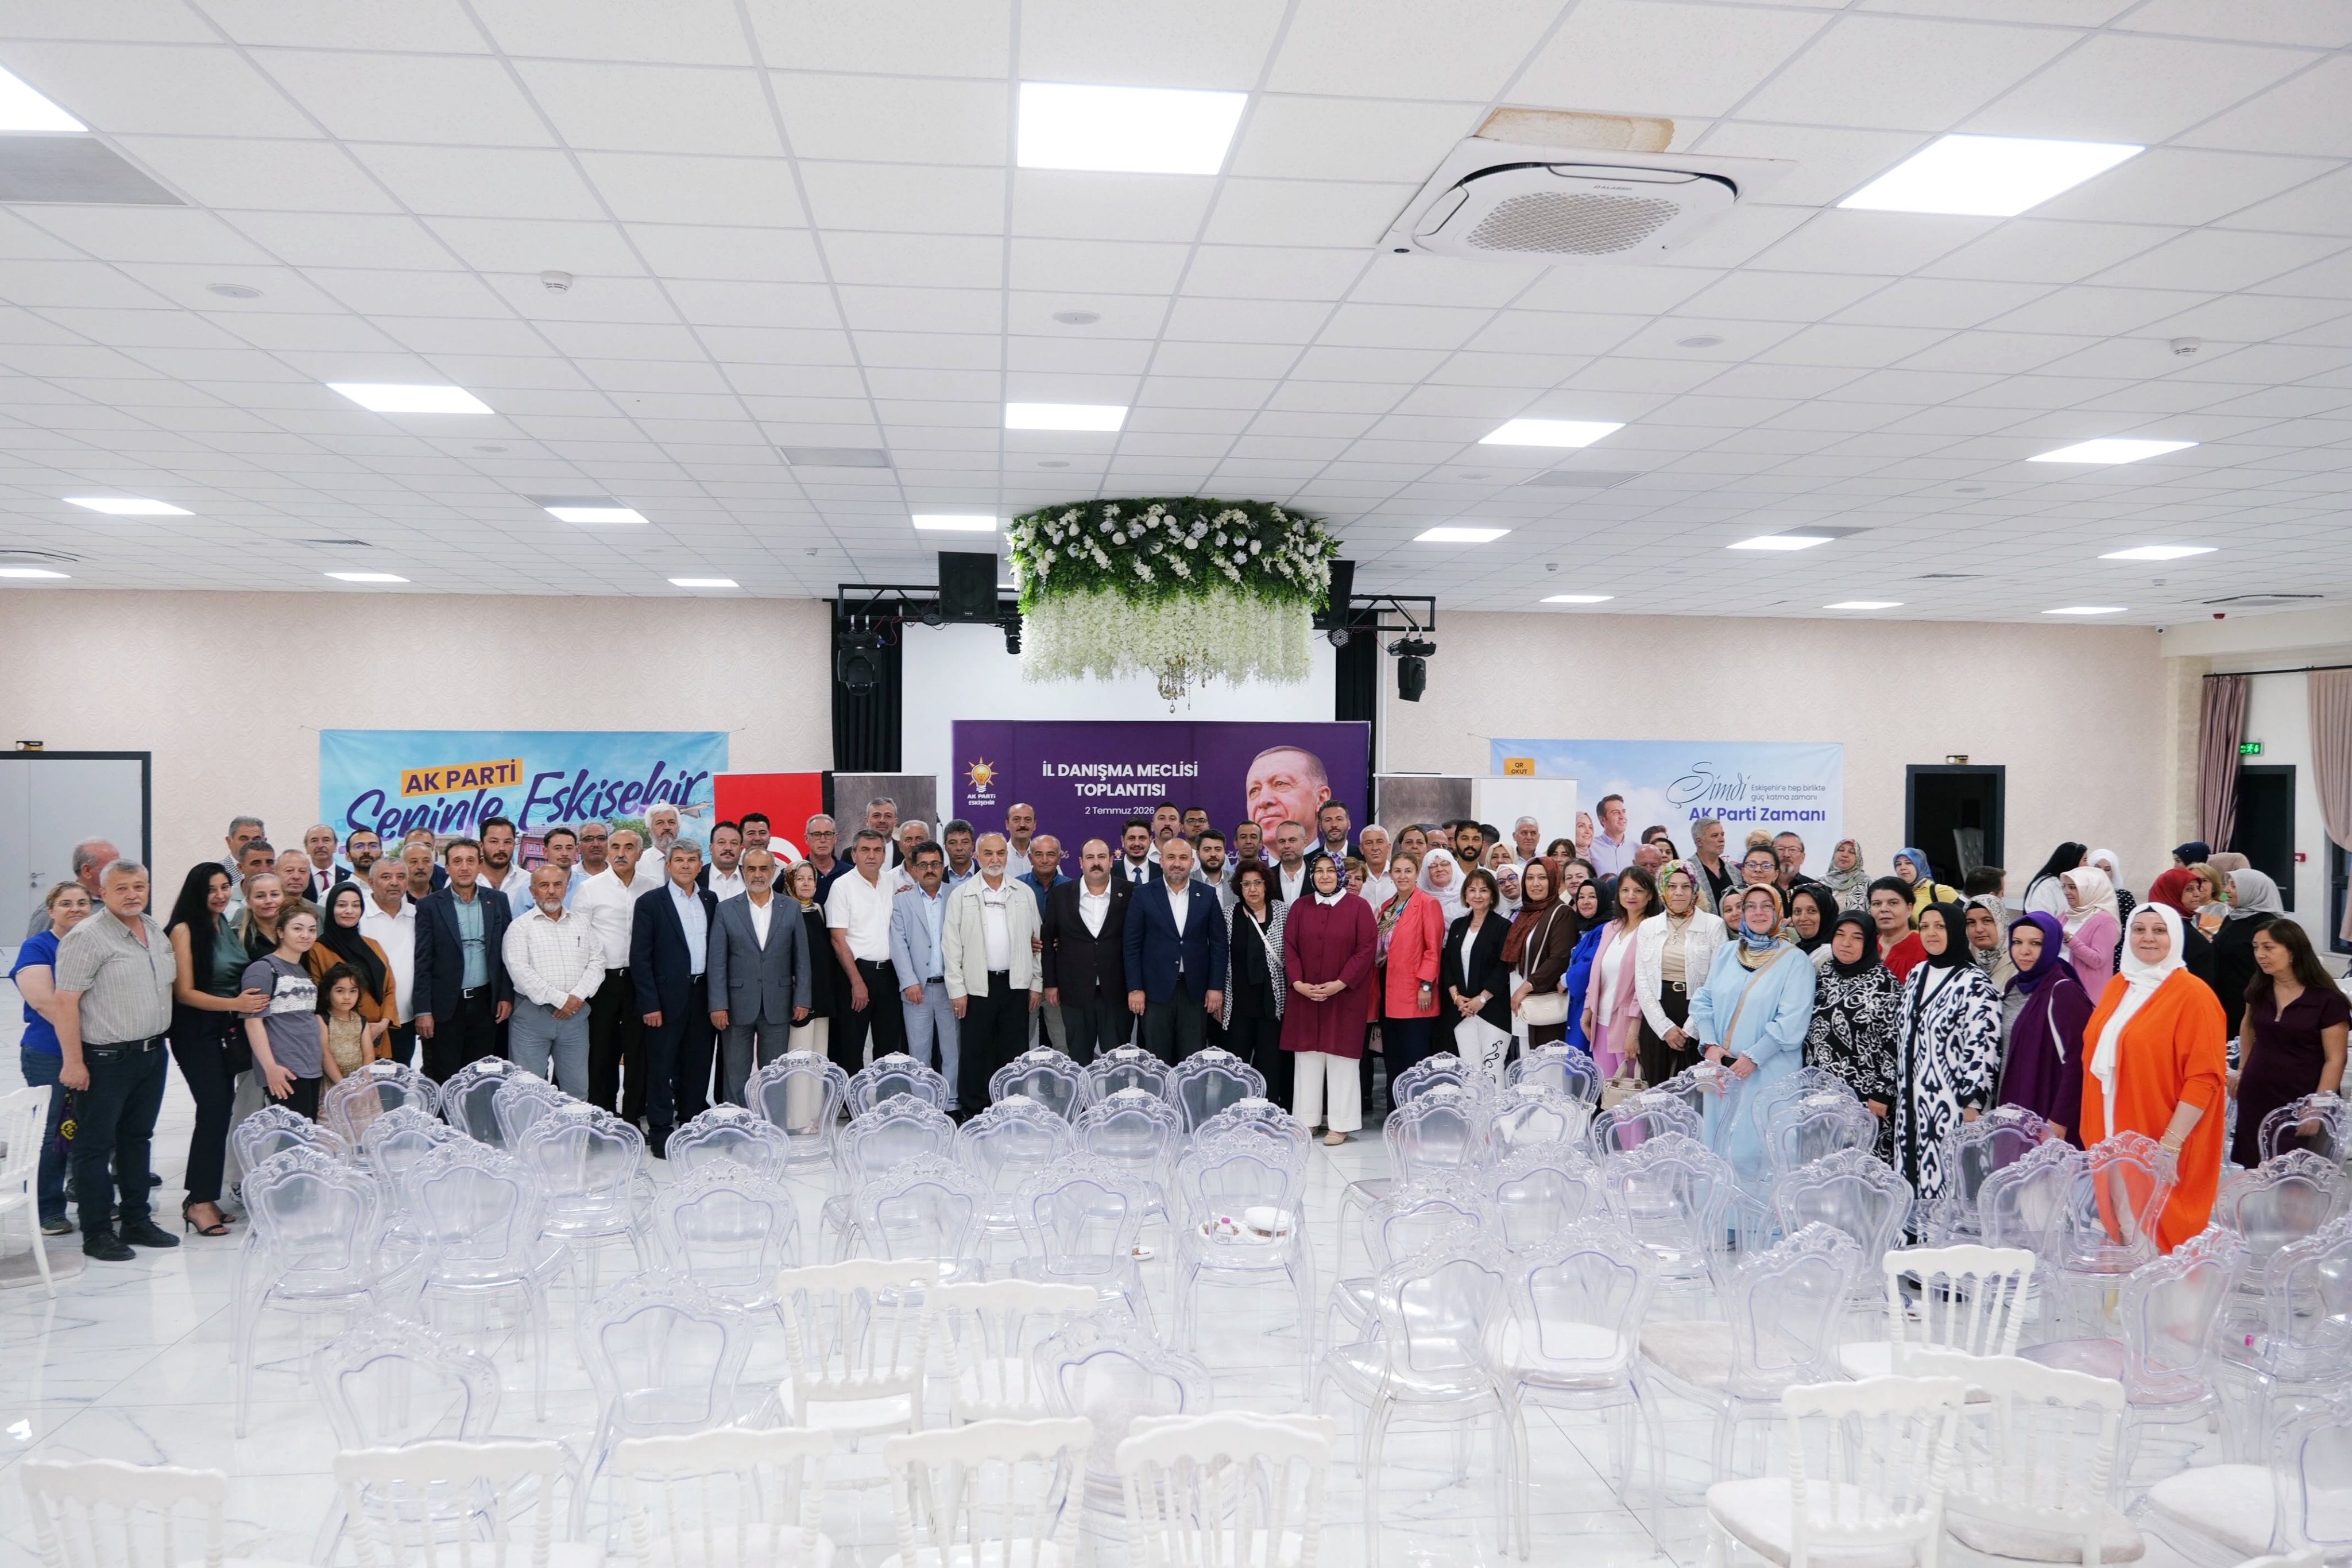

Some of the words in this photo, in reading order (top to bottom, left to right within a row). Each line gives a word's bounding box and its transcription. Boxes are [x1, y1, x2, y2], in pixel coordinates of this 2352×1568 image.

[405, 772, 440, 793] AK
[446, 759, 516, 788] PARTİ
[1042, 761, 1055, 776] İL
[1058, 764, 1134, 781] DANIŞMA
[1137, 761, 1198, 777] MECLİSİ
[1074, 784, 1166, 796] TOPLANTISI
[1751, 784, 1786, 793] Eskişehir'e
[346, 789, 504, 842] Seninle
[518, 761, 708, 832] Eskişehir
[1751, 793, 1765, 802] güç
[1085, 807, 1091, 815] 2
[1093, 807, 1131, 815] Temmuz
[1133, 807, 1155, 815] 2026
[1689, 807, 1712, 820] AK
[1717, 806, 1757, 821] Parti
[1760, 808, 1825, 821] Zamanı
